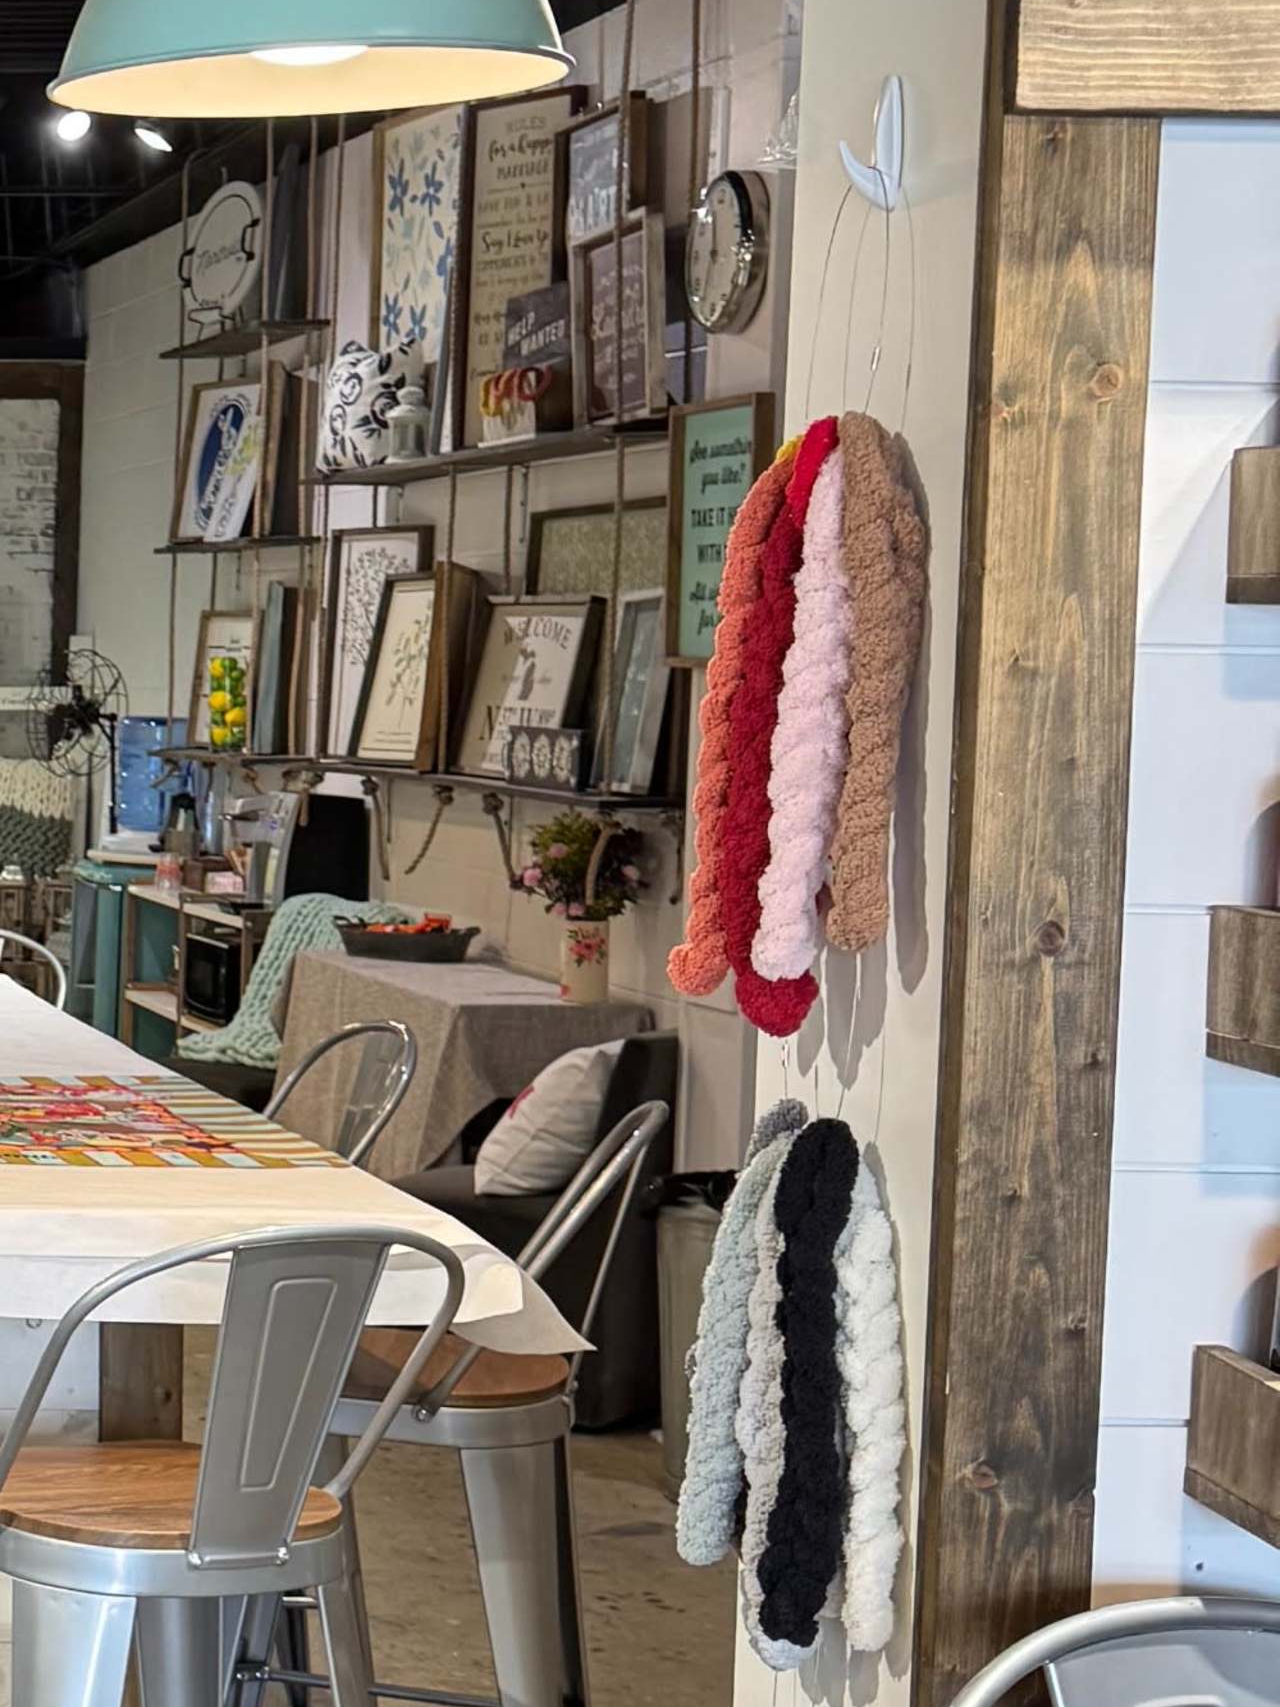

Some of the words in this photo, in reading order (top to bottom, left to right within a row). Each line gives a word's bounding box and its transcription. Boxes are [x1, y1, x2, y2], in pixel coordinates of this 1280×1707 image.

[507, 311, 536, 347] HELP
[520, 318, 565, 357] WANTED
[691, 507, 715, 528] TAKE
[716, 506, 726, 526] IT
[697, 543, 722, 564] WITH
[503, 616, 573, 651] WELCOME
